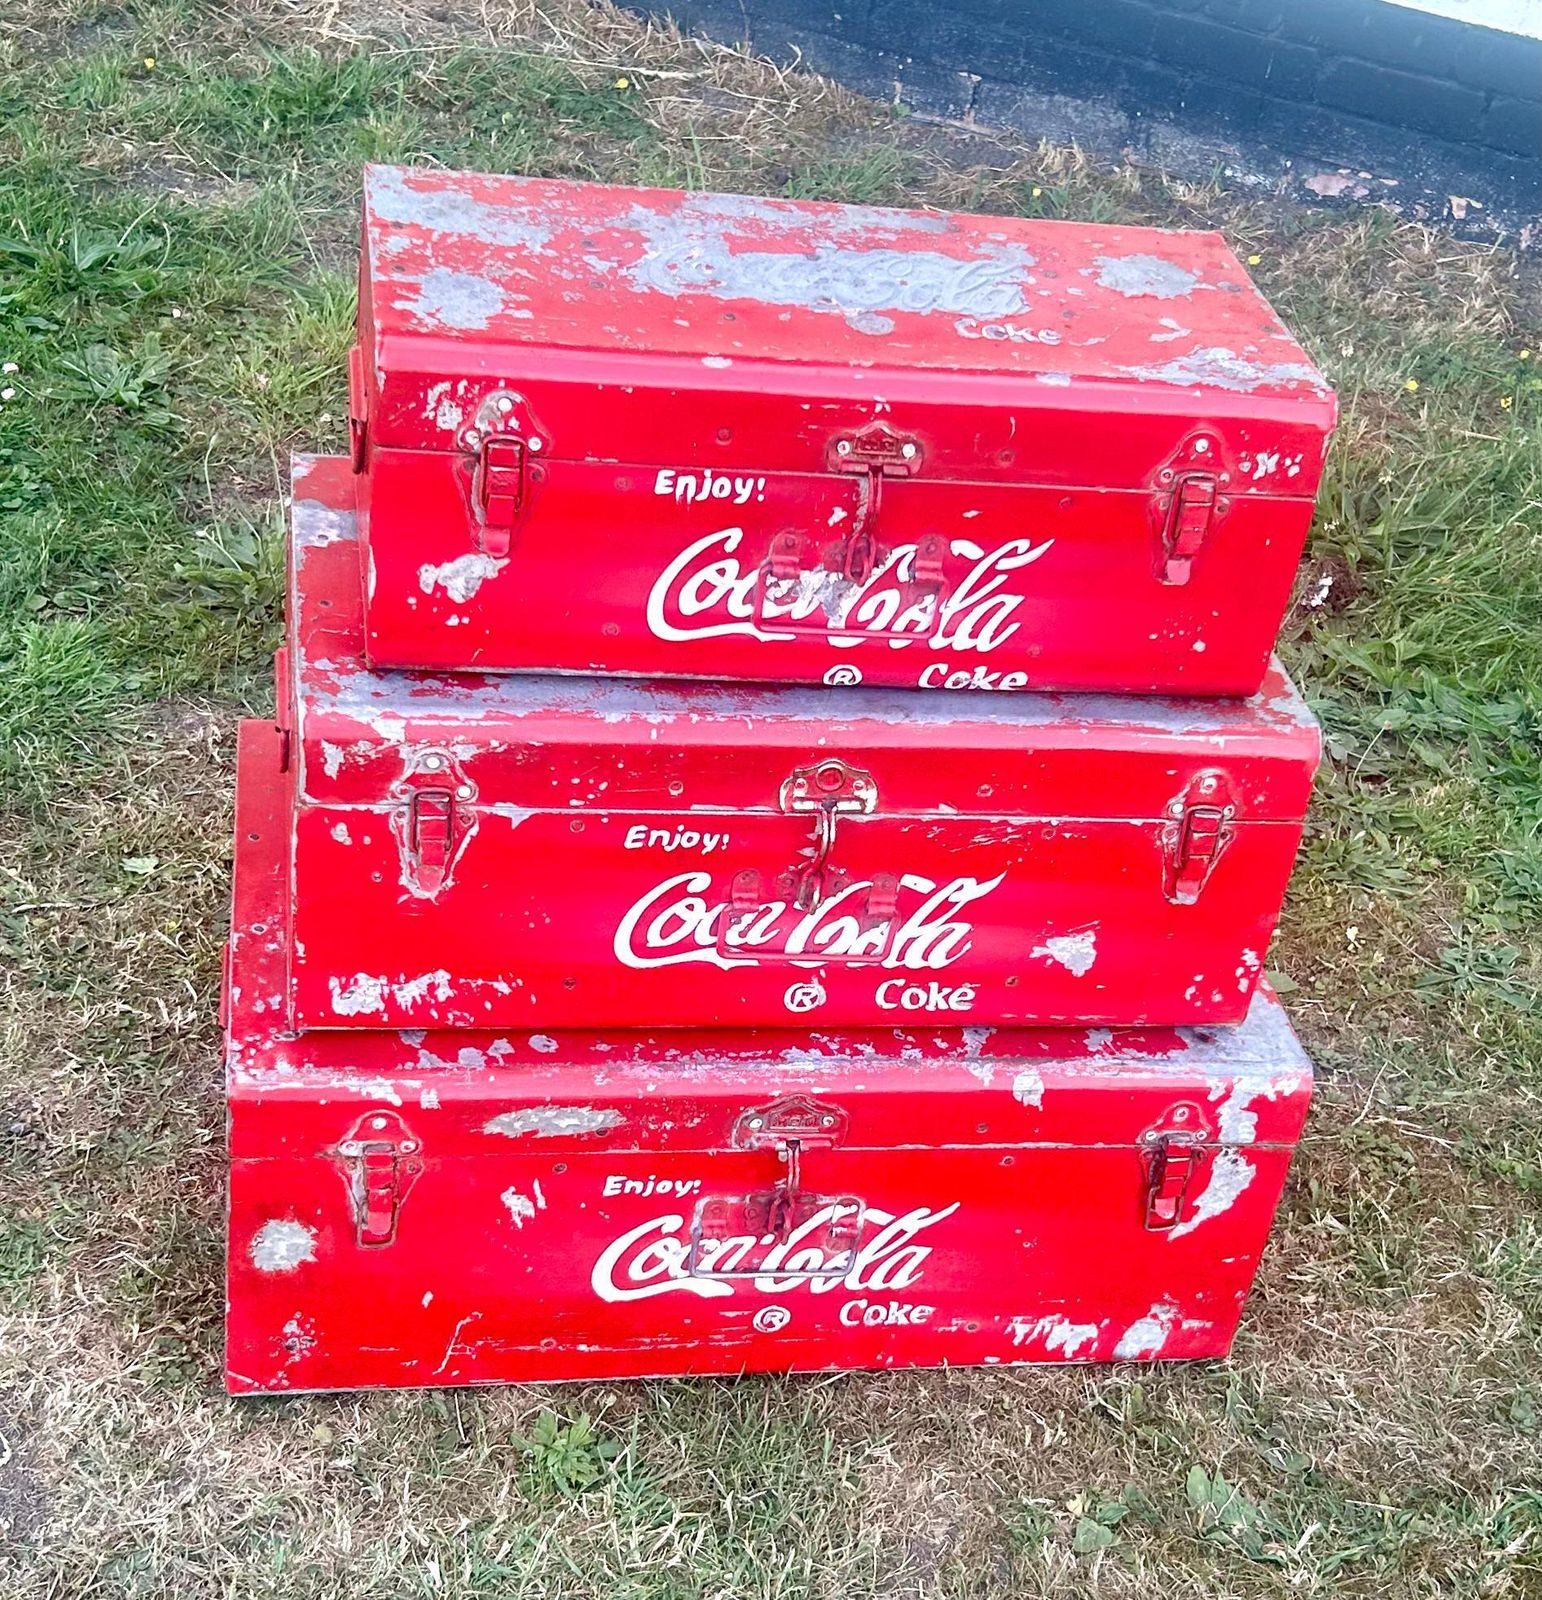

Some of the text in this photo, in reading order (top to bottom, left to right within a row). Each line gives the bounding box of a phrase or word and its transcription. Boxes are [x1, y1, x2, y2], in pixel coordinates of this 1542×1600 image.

[954, 319, 1062, 345] Coke
[654, 468, 766, 504] Enjoy!
[646, 527, 1056, 652] CocaCola
[918, 663, 1029, 690] Coke
[624, 824, 730, 854] Enjoy!
[875, 978, 977, 1011] Coke
[602, 1174, 702, 1198] Enjoy!
[839, 1299, 936, 1327] Coke
